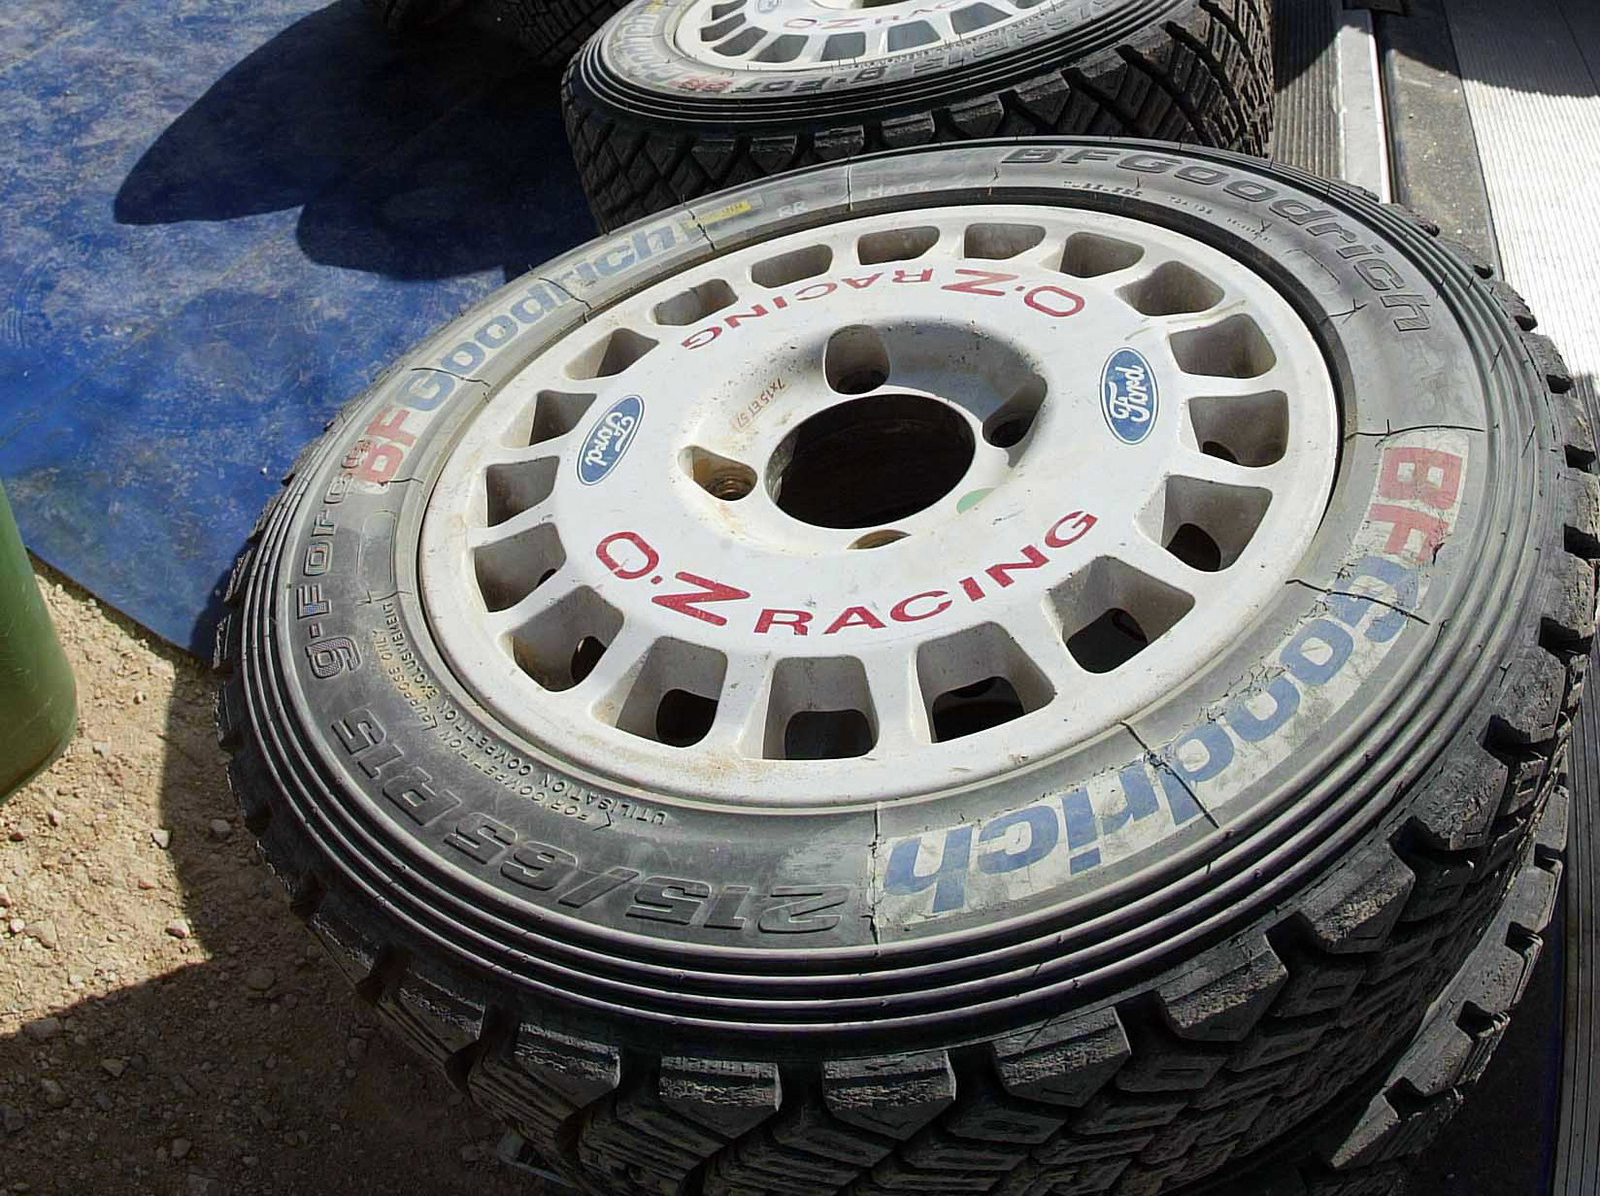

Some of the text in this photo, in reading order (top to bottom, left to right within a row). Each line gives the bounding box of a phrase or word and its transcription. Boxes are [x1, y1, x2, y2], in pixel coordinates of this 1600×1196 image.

[1001, 146, 1431, 332] BFGoodrich
[681, 267, 1087, 350] O.Z RACING
[353, 216, 679, 485] BFGoodrich
[1106, 362, 1148, 430] Ford
[583, 408, 645, 472] Ford
[596, 510, 1099, 636] O.Z RACING
[382, 602, 669, 826] UTILISATION COMPETITION EXCLUSIVEMENT
[388, 666, 433, 725] PURPOSE
[885, 446, 1463, 912] BFGoodrich
[438, 730, 548, 803] COMPETITION
[550, 800, 591, 822] FOR
